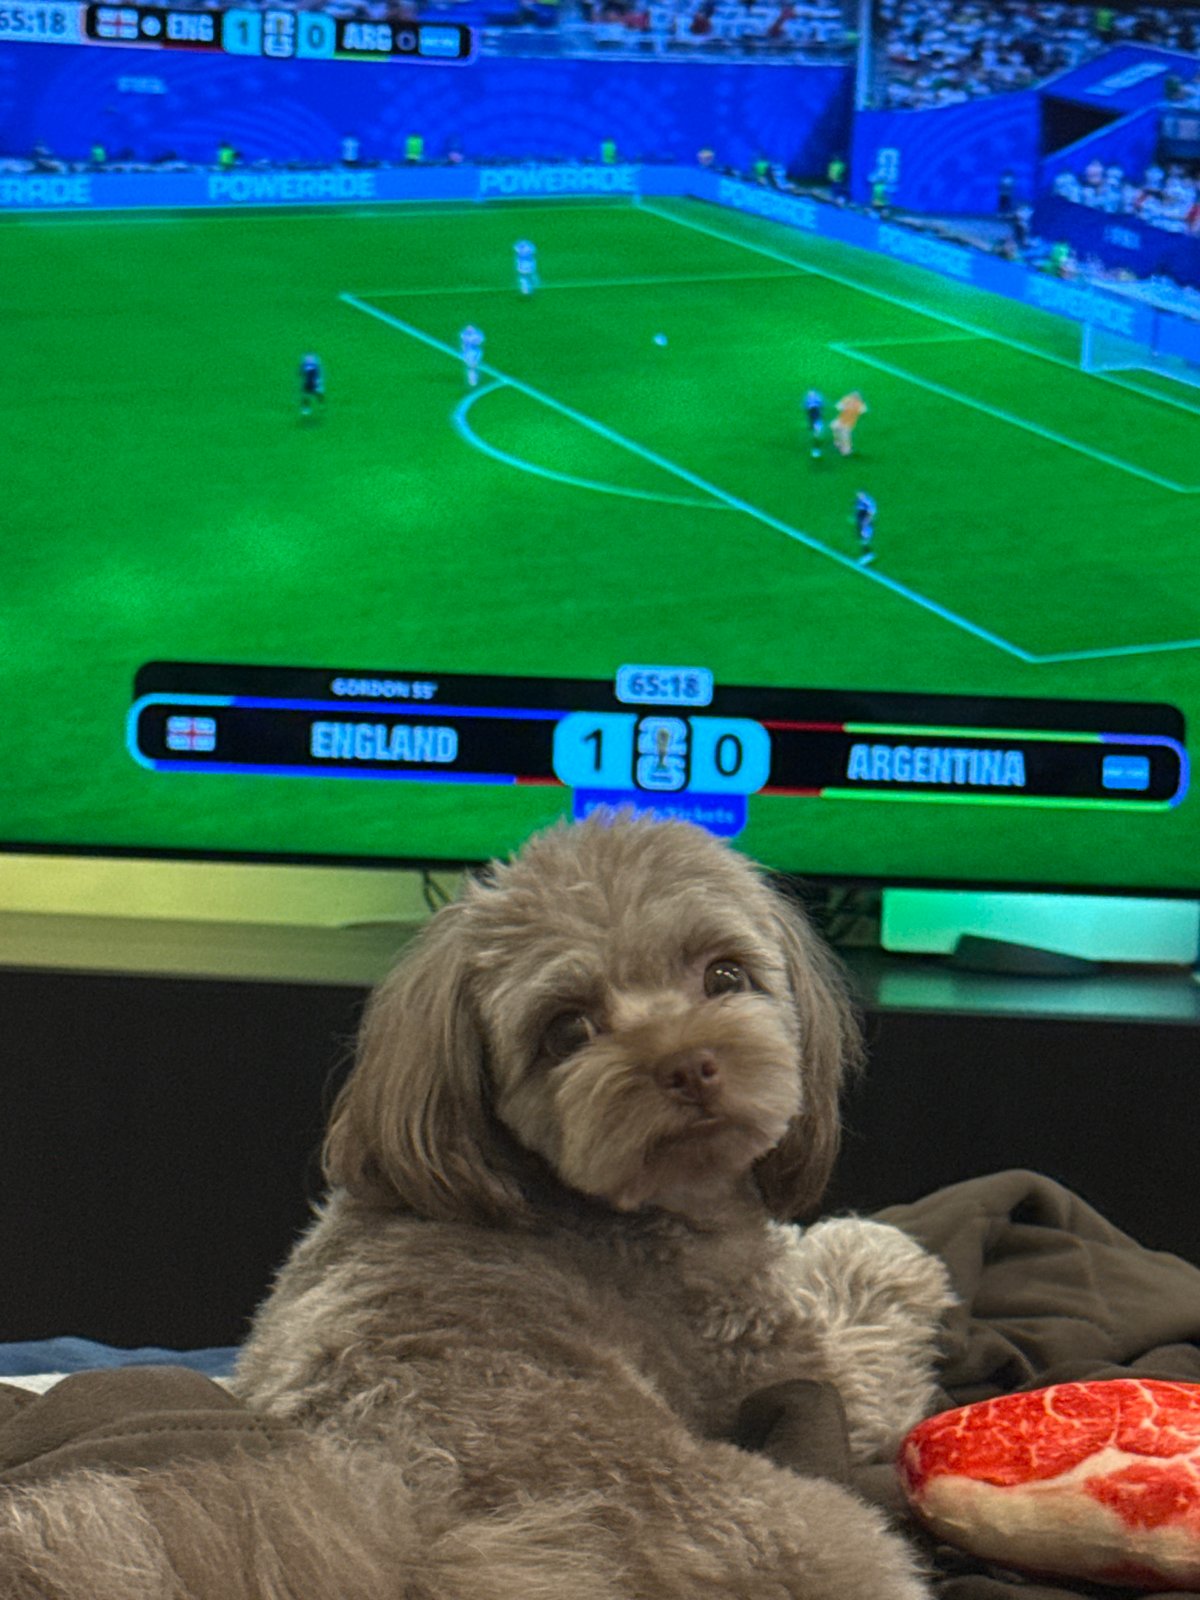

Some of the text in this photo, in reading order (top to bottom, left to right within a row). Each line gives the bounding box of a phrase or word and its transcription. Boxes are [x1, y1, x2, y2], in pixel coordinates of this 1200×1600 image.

[167, 13, 213, 41] ENG
[236, 21, 249, 46] 1
[307, 24, 325, 49] 0
[343, 23, 392, 51] ARG
[208, 172, 375, 201] POWERADE
[479, 167, 637, 194] POWERADE
[331, 677, 410, 698] GORDON
[629, 672, 700, 698] 65:18
[310, 721, 1025, 787] ENGLAND 1 0 ARGENTINA
